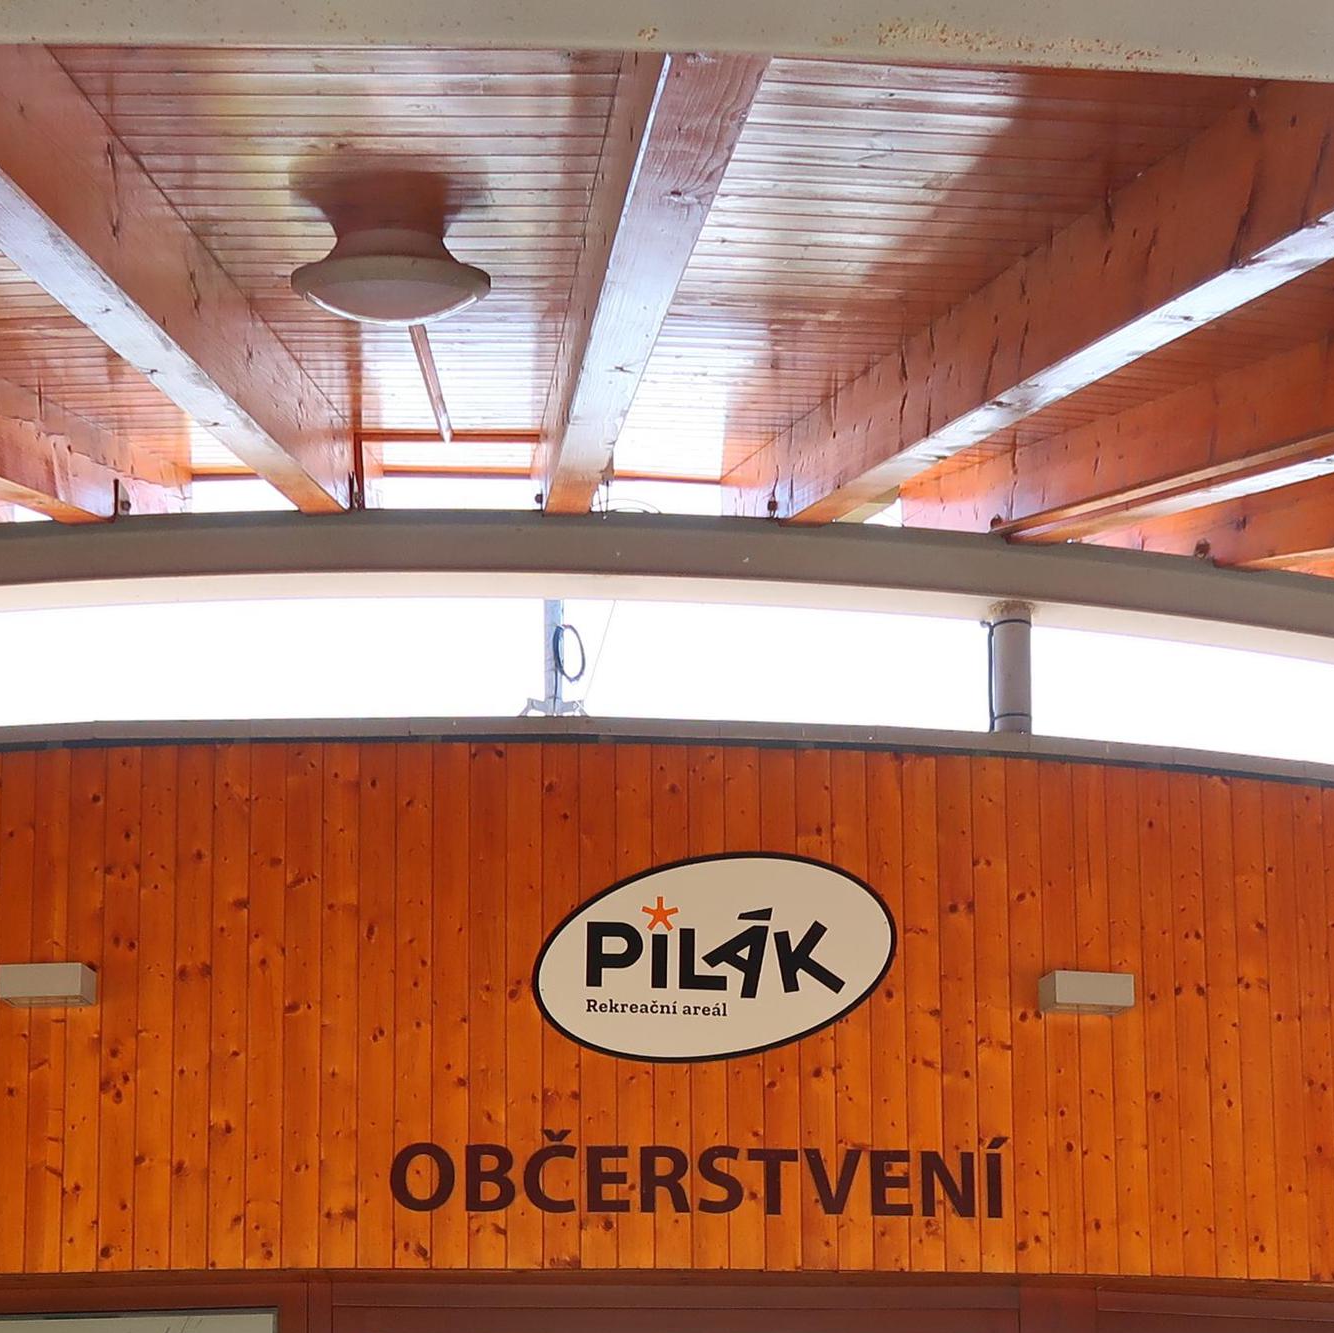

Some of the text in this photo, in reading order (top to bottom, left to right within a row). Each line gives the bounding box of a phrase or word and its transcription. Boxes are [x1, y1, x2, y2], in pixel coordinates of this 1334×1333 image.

[585, 998, 728, 1018] Rekreační areál
[387, 1128, 1004, 1219] OBČERSTVENÍ
